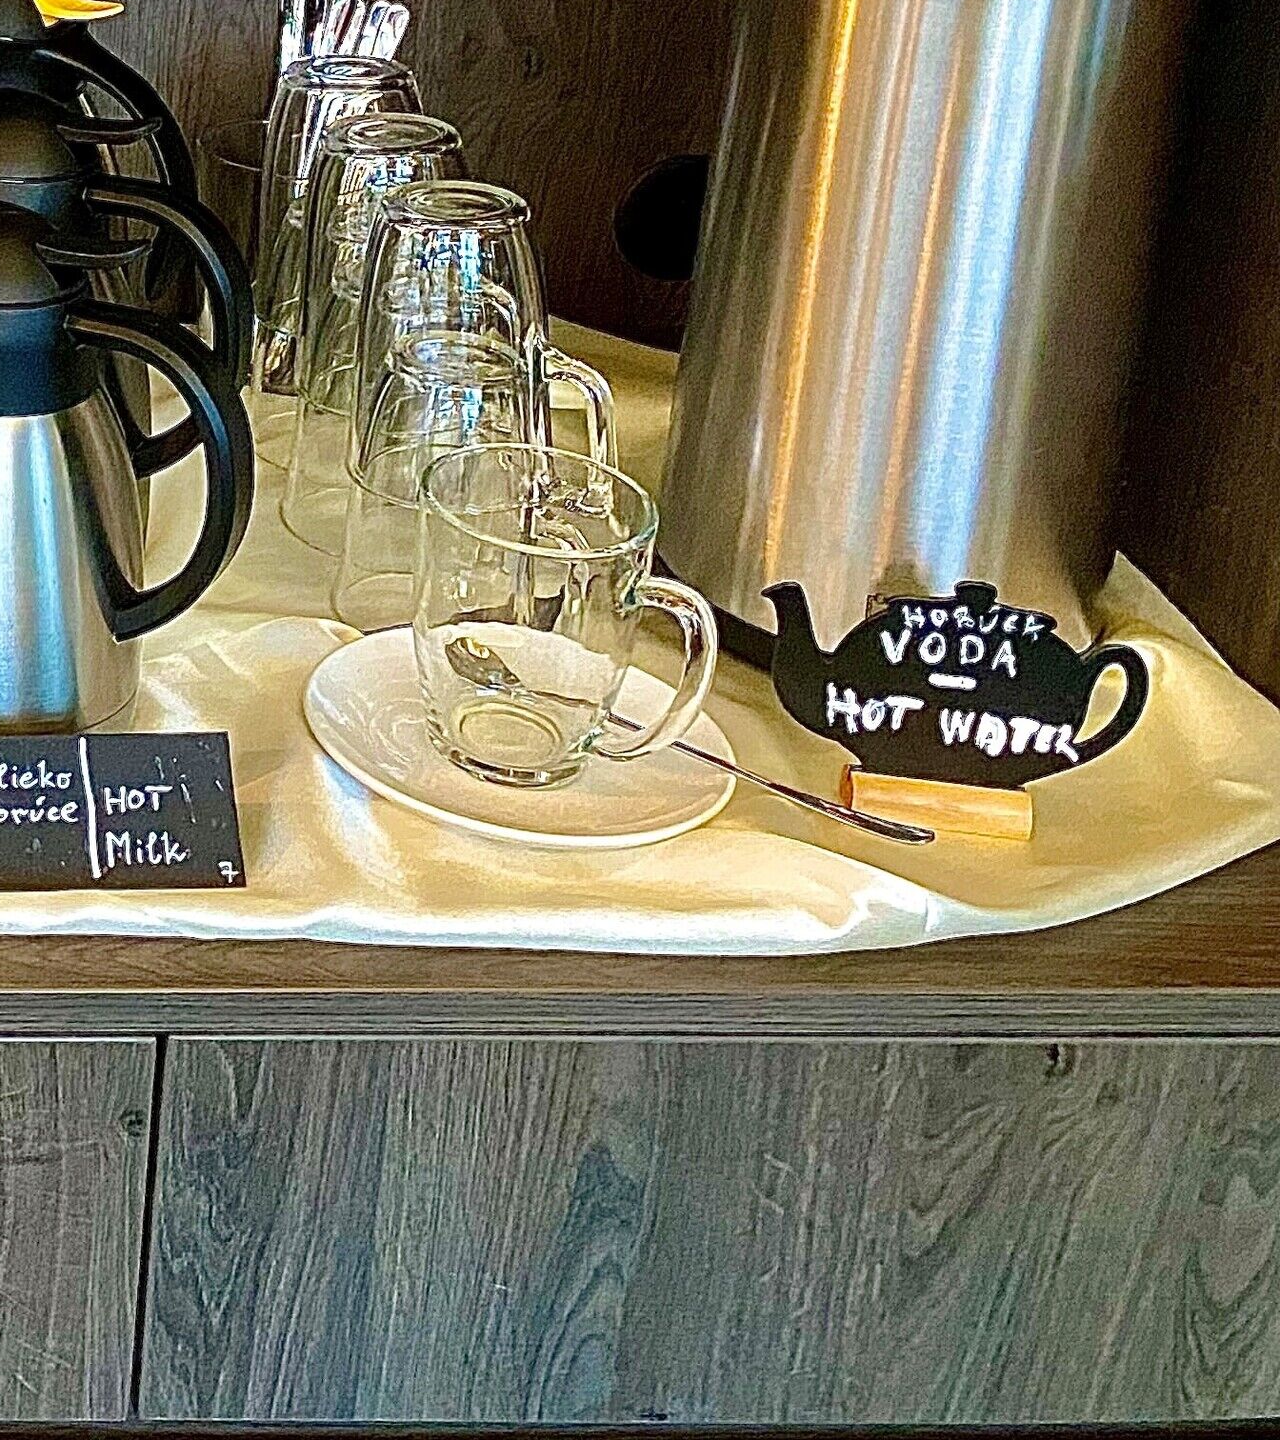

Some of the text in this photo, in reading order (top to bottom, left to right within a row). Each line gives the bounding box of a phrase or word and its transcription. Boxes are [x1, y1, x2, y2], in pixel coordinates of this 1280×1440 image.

[880, 629, 1017, 678] VODA
[826, 681, 1079, 763] HOT WATER
[103, 785, 173, 816] HOT
[105, 830, 186, 868] Milk
[218, 861, 239, 883] 7
